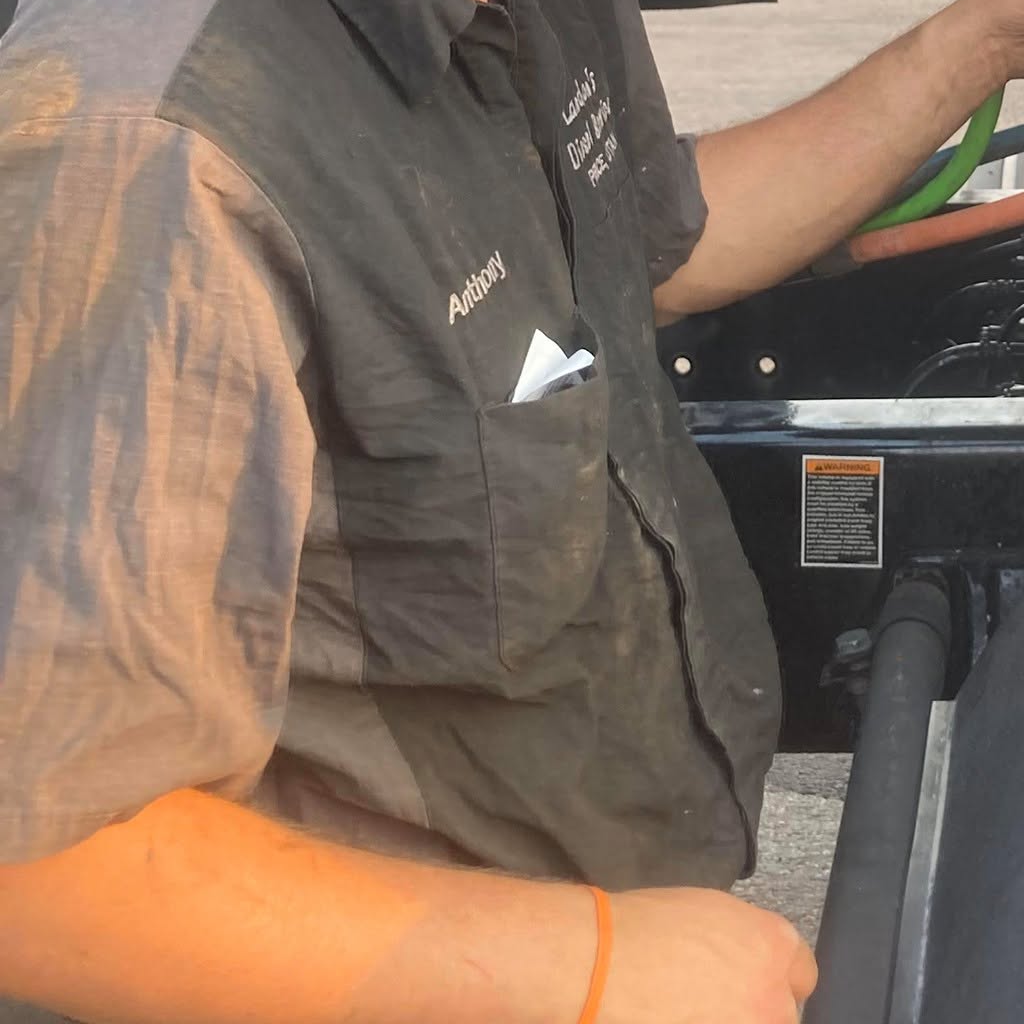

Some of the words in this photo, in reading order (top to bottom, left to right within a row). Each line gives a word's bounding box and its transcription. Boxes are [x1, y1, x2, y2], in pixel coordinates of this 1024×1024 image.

[562, 66, 596, 126] Landon's
[566, 120, 594, 171] Diesel
[448, 250, 507, 325] Anthony
[824, 462, 871, 473] WARNING
